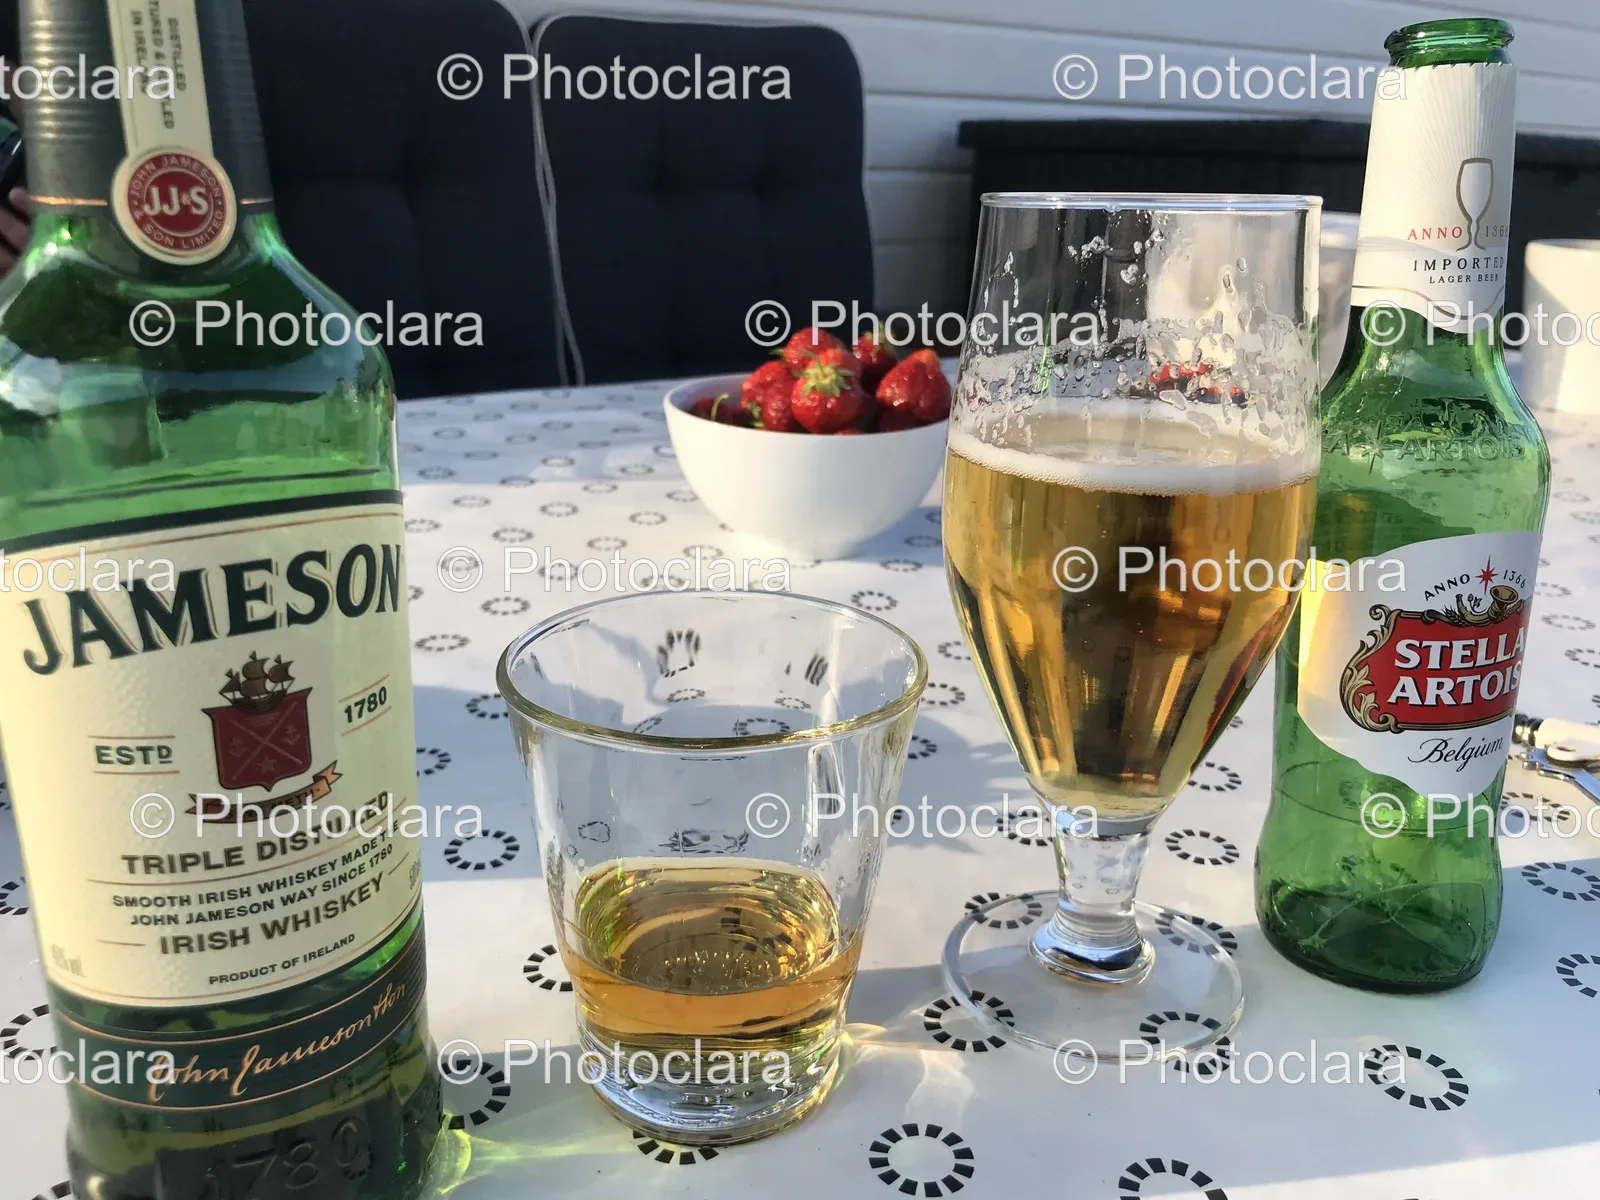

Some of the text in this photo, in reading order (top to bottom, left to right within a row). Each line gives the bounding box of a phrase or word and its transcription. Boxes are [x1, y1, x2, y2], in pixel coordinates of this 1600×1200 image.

[131, 156, 223, 198] JOHN JAMESON
[144, 223, 175, 247] SON
[182, 211, 224, 249] LIMITED
[1407, 226, 1463, 240] ANNO
[1413, 257, 1504, 271] IMPORTED
[1429, 275, 1472, 284] LAGER
[1424, 569, 1527, 601] ANNO 1366
[23, 543, 402, 676] JAMESON
[1394, 626, 1526, 671] STELLA
[1387, 660, 1522, 706] ARTOIS
[344, 686, 387, 723] 1780
[1407, 736, 1505, 772] Belgium
[113, 894, 192, 908] SMOOTH
[198, 886, 252, 904] IRISH
[257, 858, 337, 895] WHISKEY
[341, 838, 378, 866] MADE
[121, 846, 245, 874] TRIPLE
[130, 843, 393, 926] JOHN JAMESON WAY SINCE 1780
[160, 926, 250, 955] IRISH
[260, 871, 384, 940] WHISKEY
[209, 933, 356, 985] PRODUCT OF IRELAND
